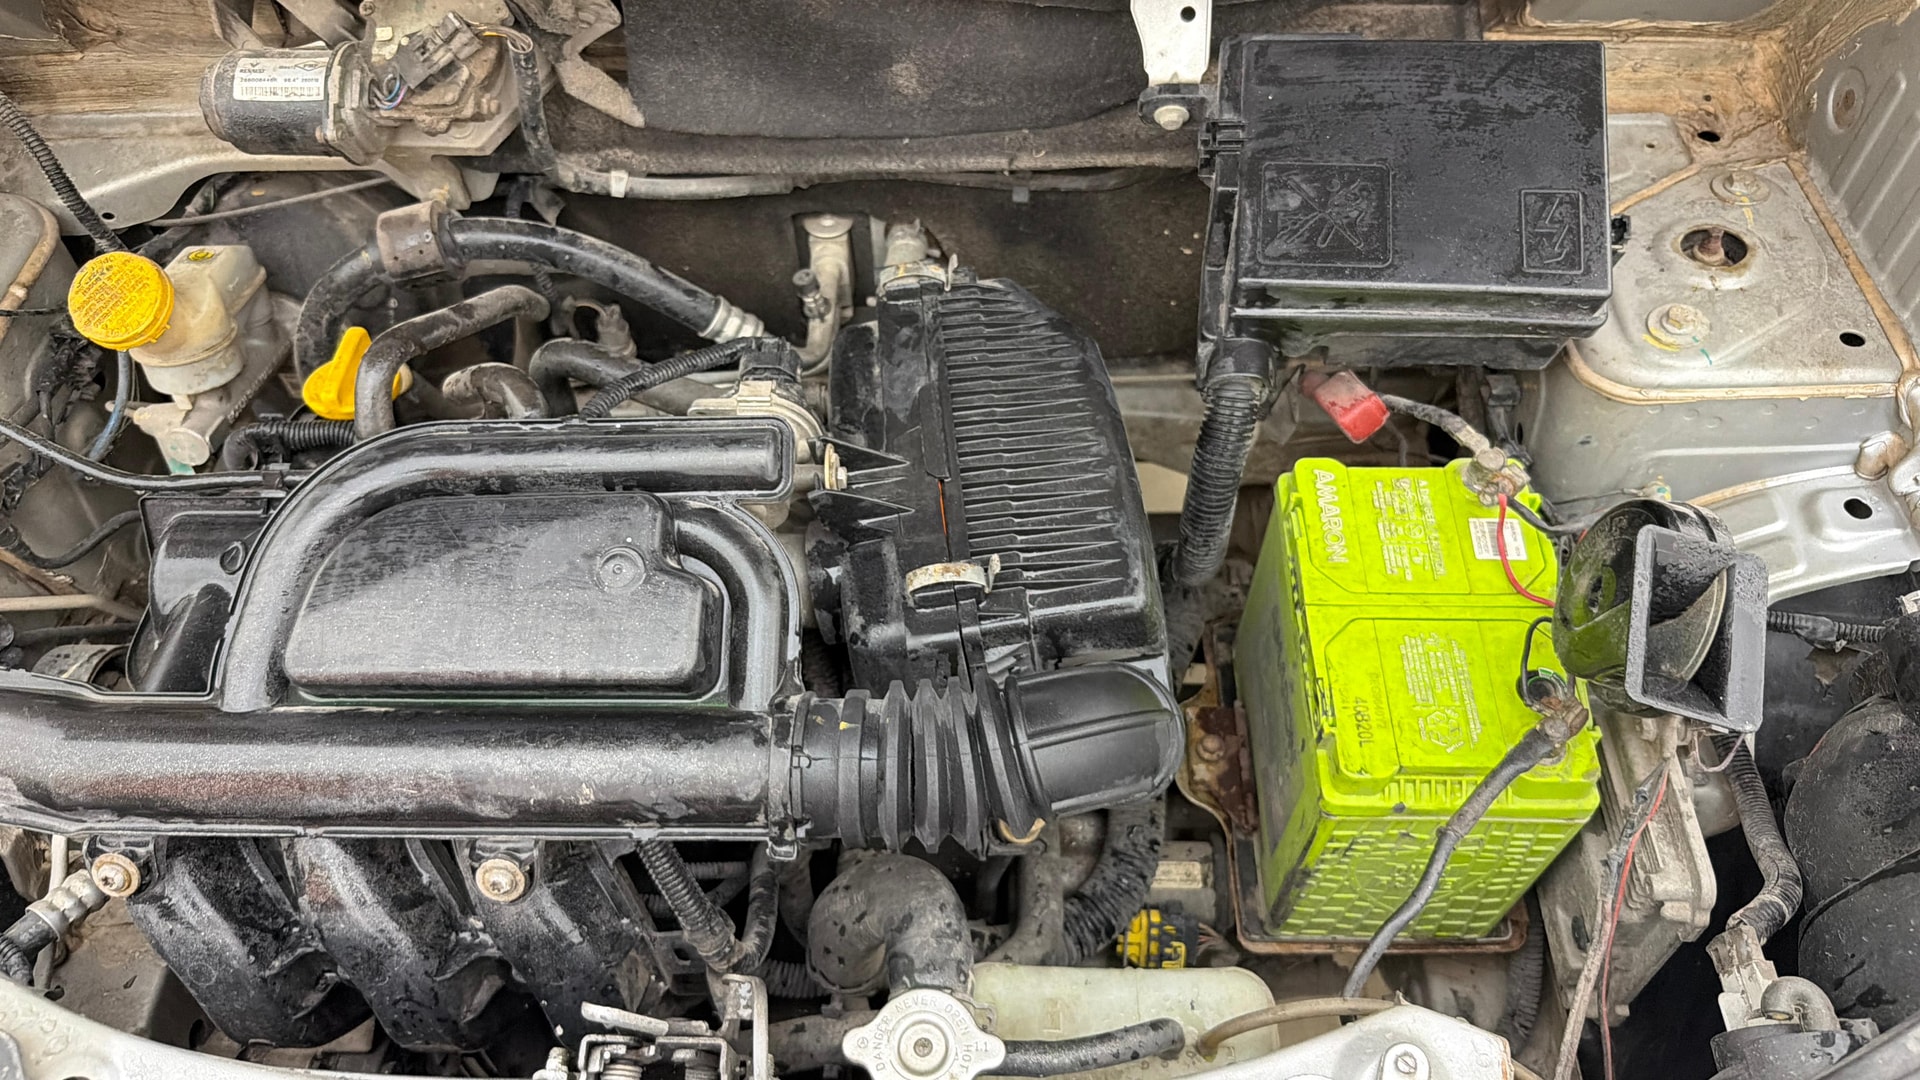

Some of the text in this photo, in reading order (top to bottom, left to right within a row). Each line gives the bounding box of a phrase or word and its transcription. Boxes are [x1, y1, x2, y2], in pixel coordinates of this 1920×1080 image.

[1313, 468, 1349, 564] AMARON
[1354, 696, 1374, 749] 40B20L
[873, 1015, 892, 1072] DANGER
[894, 995, 938, 1014] NEVER
[944, 1004, 971, 1036] OPEN
[959, 1043, 973, 1074] HOT
[974, 1041, 990, 1053] 1.1
